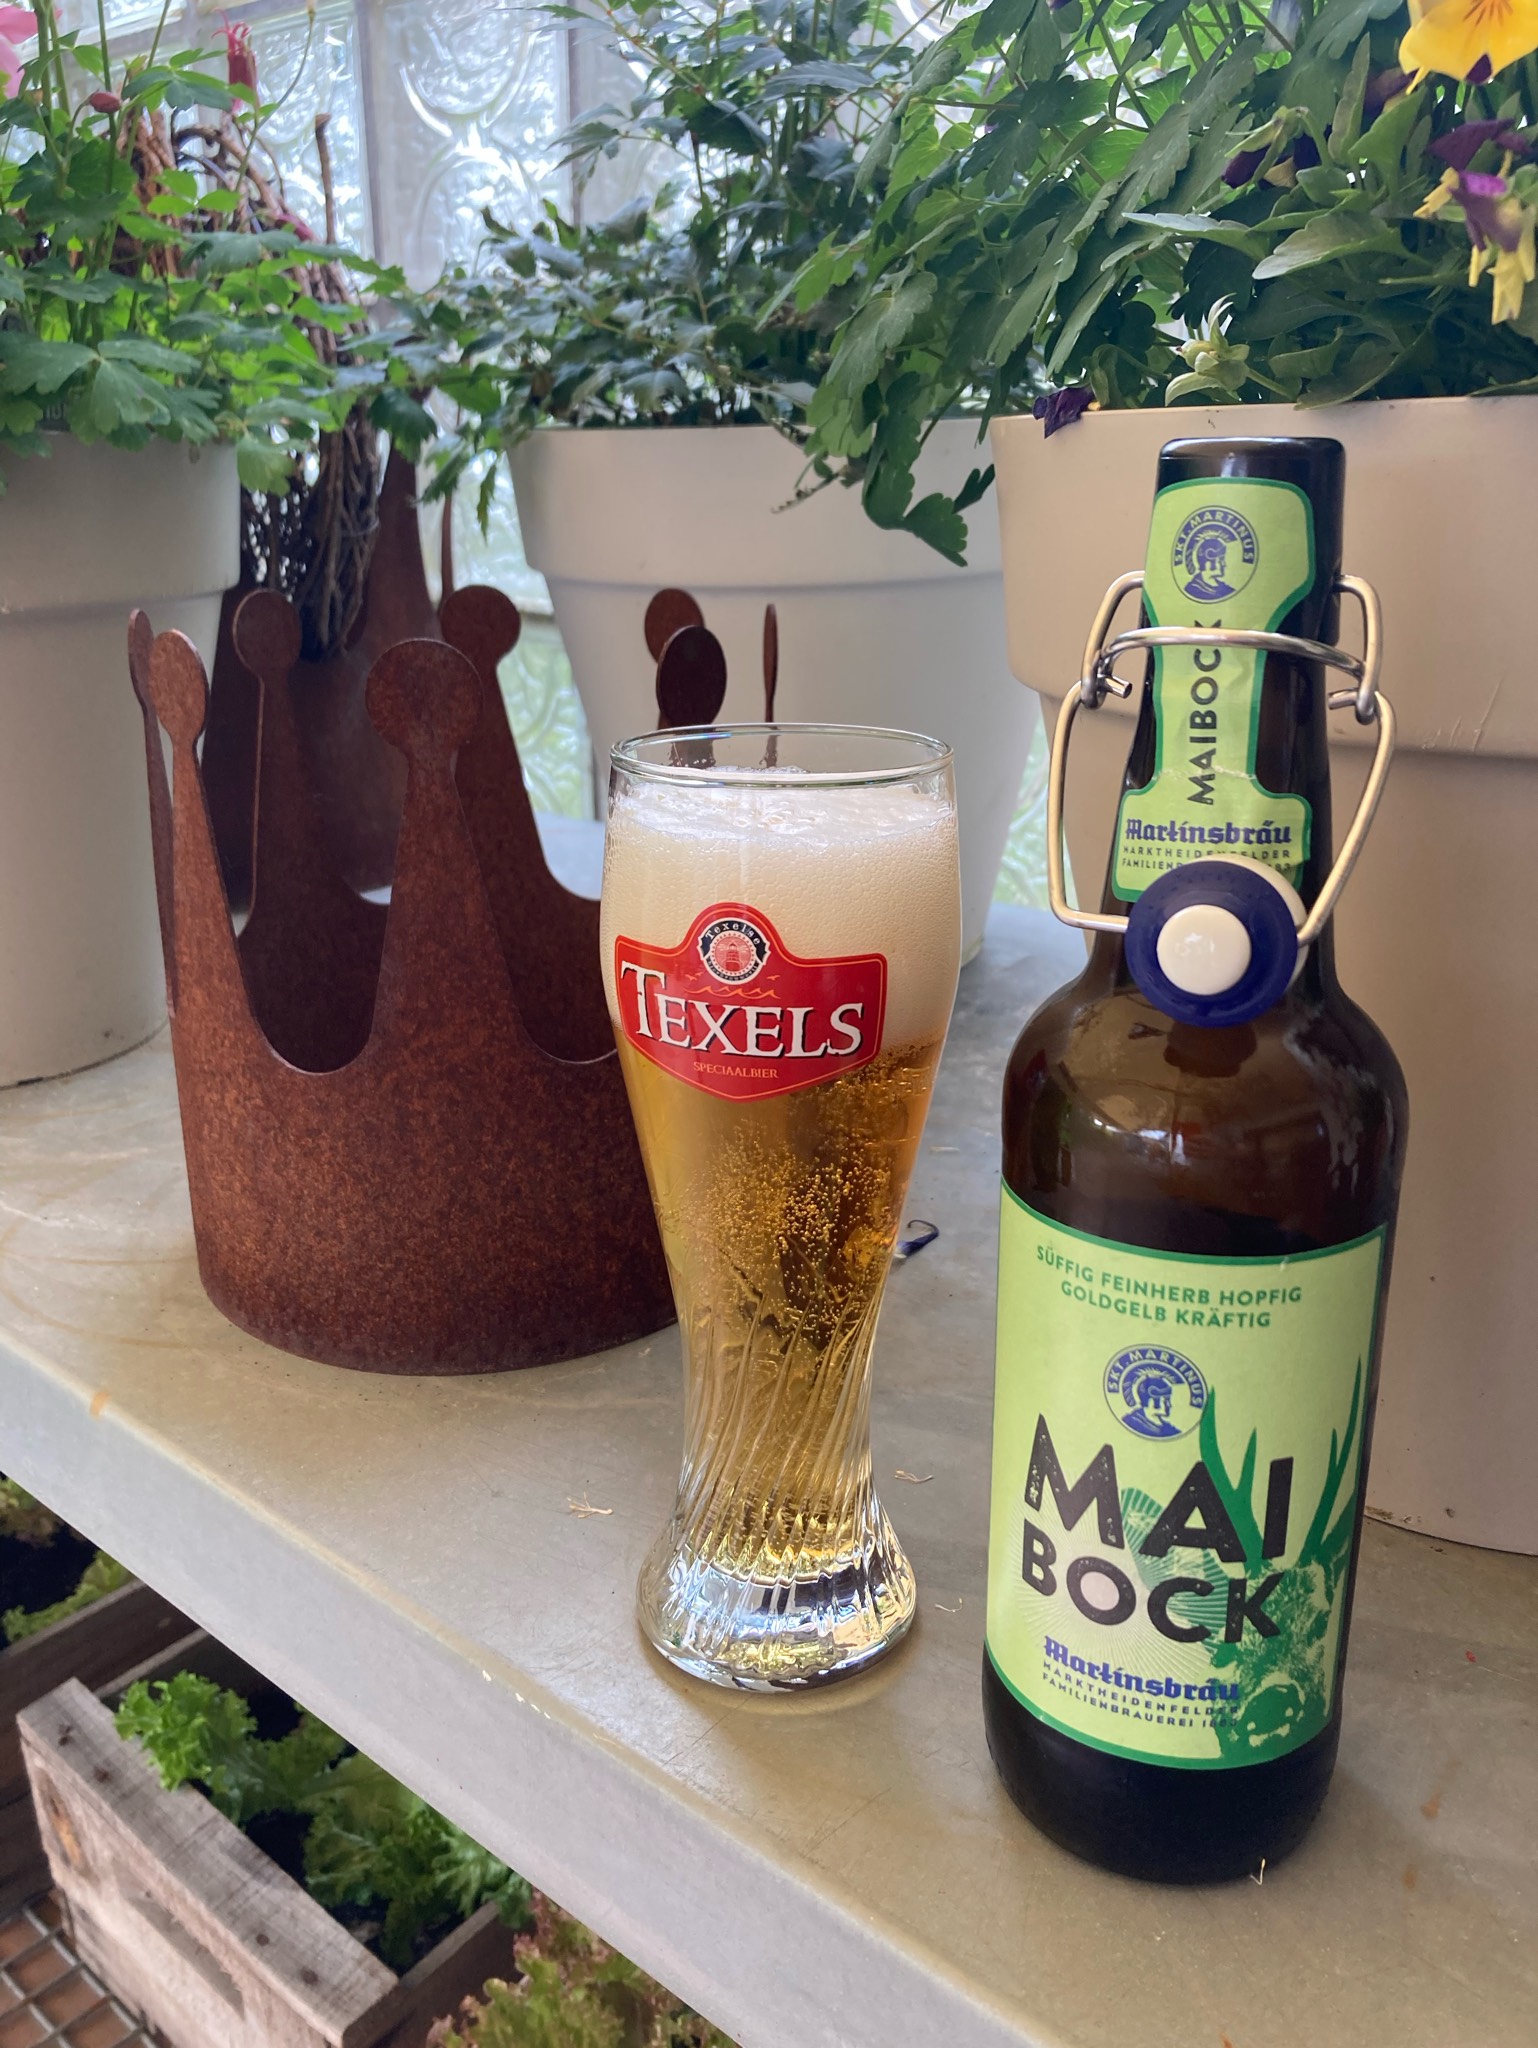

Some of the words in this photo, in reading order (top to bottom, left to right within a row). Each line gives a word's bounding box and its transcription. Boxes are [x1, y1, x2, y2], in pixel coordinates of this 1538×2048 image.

[1190, 511, 1254, 560] MARTINUS
[1125, 818, 1292, 845] Martinsbräu
[705, 923, 761, 944] Texelse
[693, 1062, 779, 1079] SPECIAALBIER
[1036, 1245, 1094, 1282] SÜFFIG
[1101, 1273, 1210, 1304] FEINHERB
[1219, 1287, 1302, 1306] HOPFIG
[1060, 1280, 1167, 1322] GOLDGELB
[1176, 1308, 1271, 1328] KRÄFTIG
[1129, 1349, 1203, 1405] MARTINUS
[1024, 1412, 1294, 1562] MAI
[1022, 1518, 1285, 1643] BOCK
[1043, 1635, 1240, 1701] Martinsbräu
[1043, 1659, 1239, 1716] MARKTHEIDENFELDER
[1043, 1672, 1194, 1728] FAMILIENBRAUEREI
